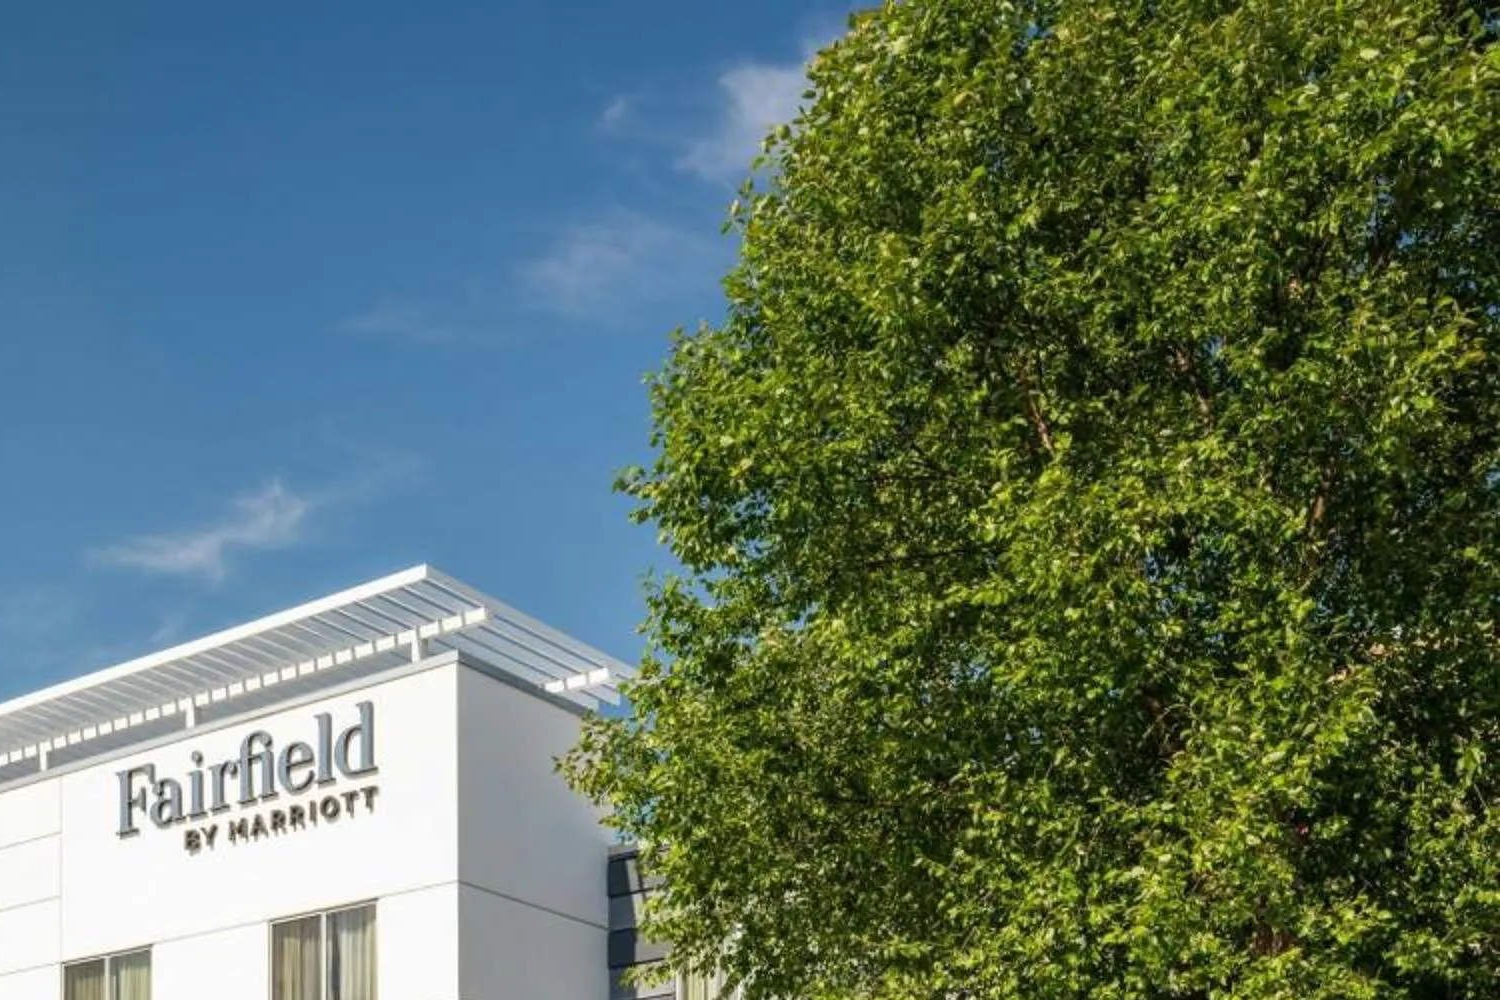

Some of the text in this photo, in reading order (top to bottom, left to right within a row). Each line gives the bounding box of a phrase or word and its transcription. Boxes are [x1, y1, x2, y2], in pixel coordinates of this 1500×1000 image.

[116, 700, 379, 839] Fairfield
[184, 786, 379, 855] BY MARRIOTT
